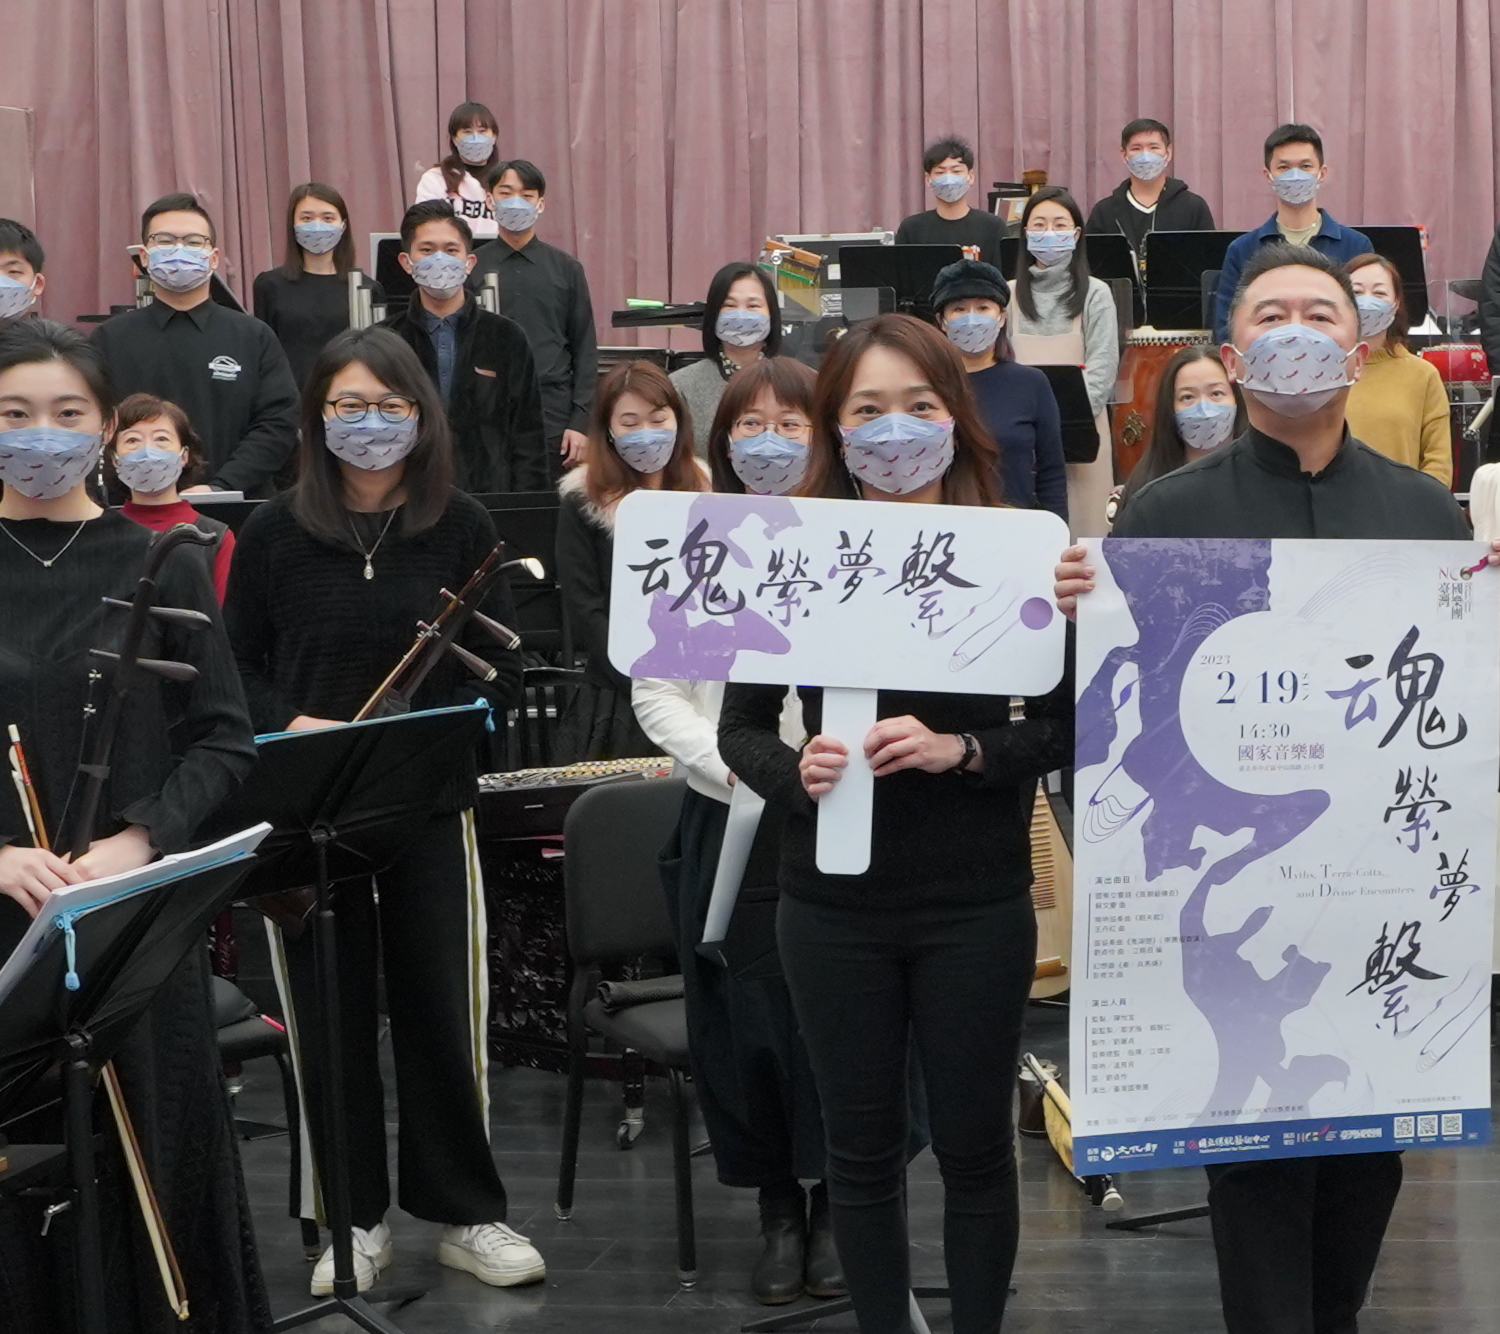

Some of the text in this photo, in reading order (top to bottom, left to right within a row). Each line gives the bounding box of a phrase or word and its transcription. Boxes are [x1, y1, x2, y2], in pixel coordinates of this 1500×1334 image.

[1200, 654, 1231, 665] 2023
[1239, 722, 1291, 739] 14:30
[1238, 742, 1326, 762] 國家音樂廳
[1296, 883, 1416, 898] and Divine Encounters
